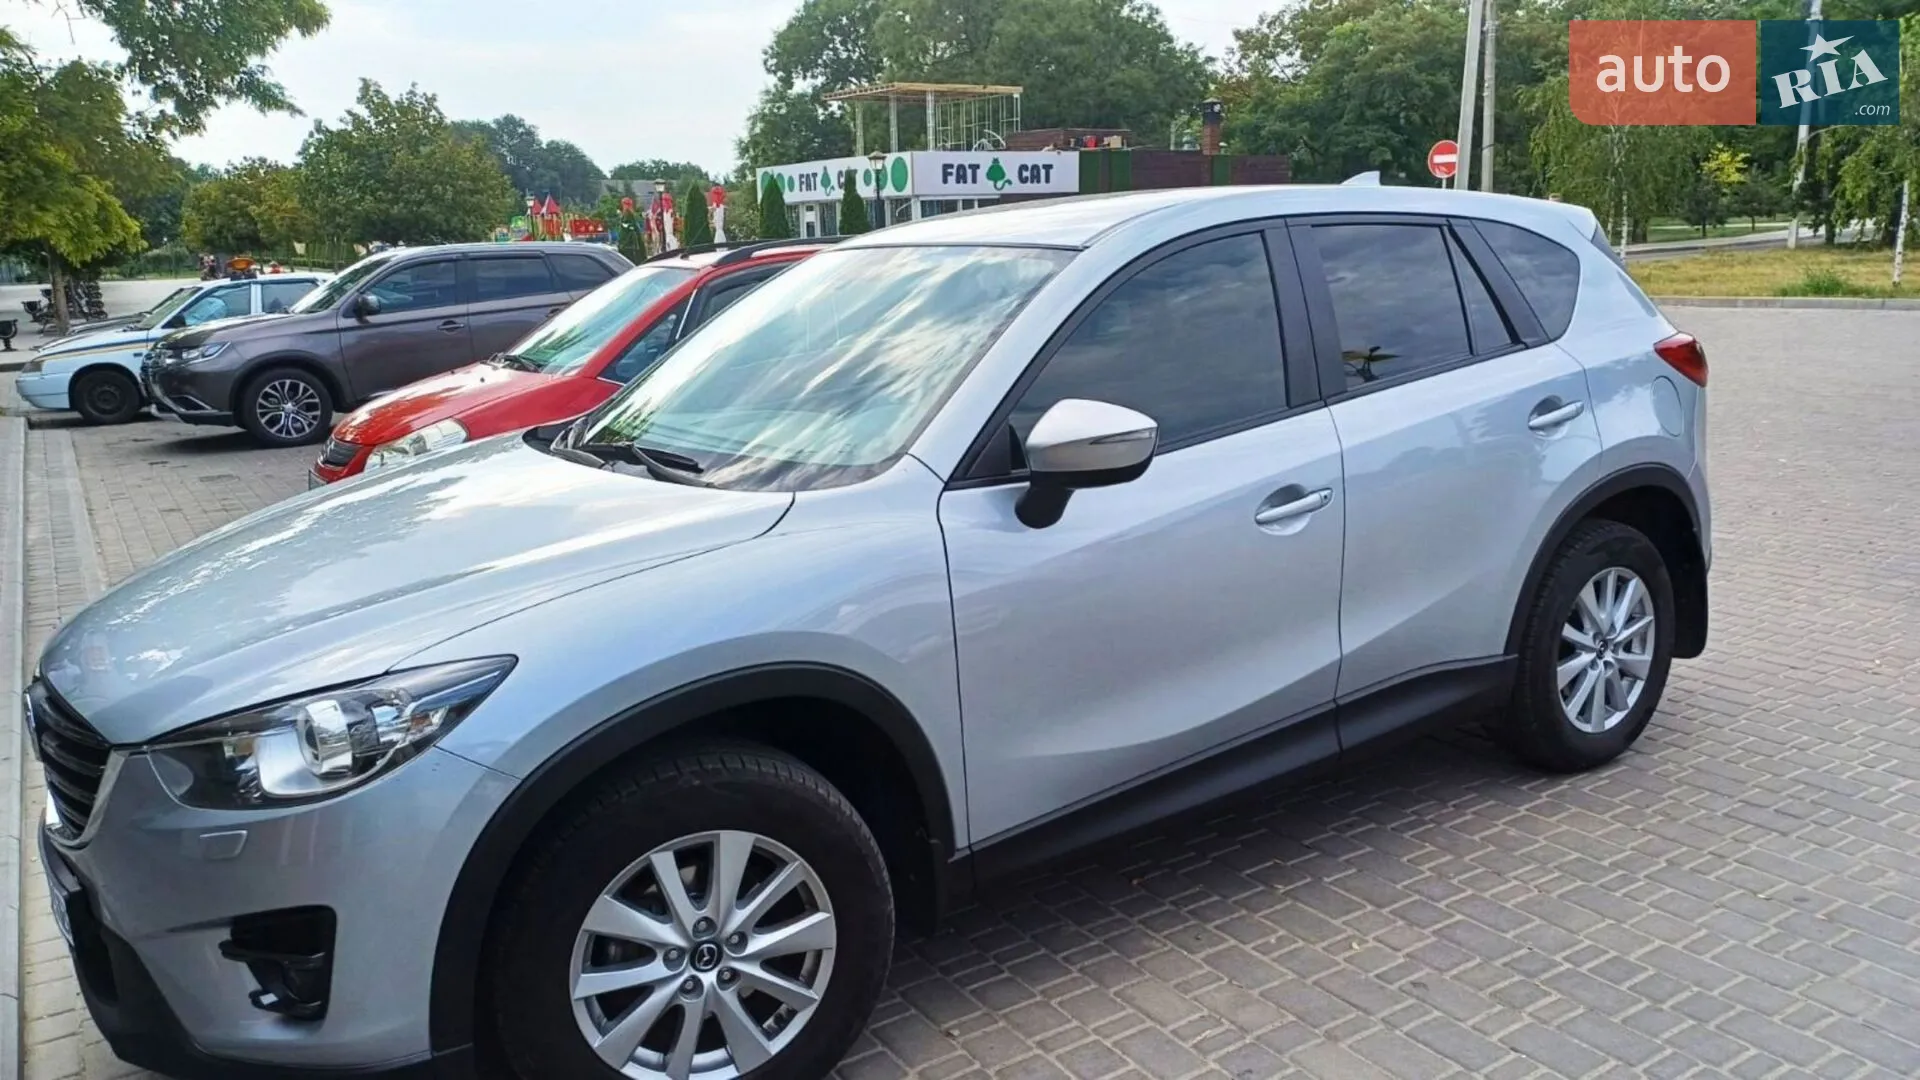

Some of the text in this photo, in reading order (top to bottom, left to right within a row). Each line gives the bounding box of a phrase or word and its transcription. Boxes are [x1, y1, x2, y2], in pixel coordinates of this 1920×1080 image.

[798, 172, 818, 192] FAT
[942, 163, 1053, 184] FAT CAT
